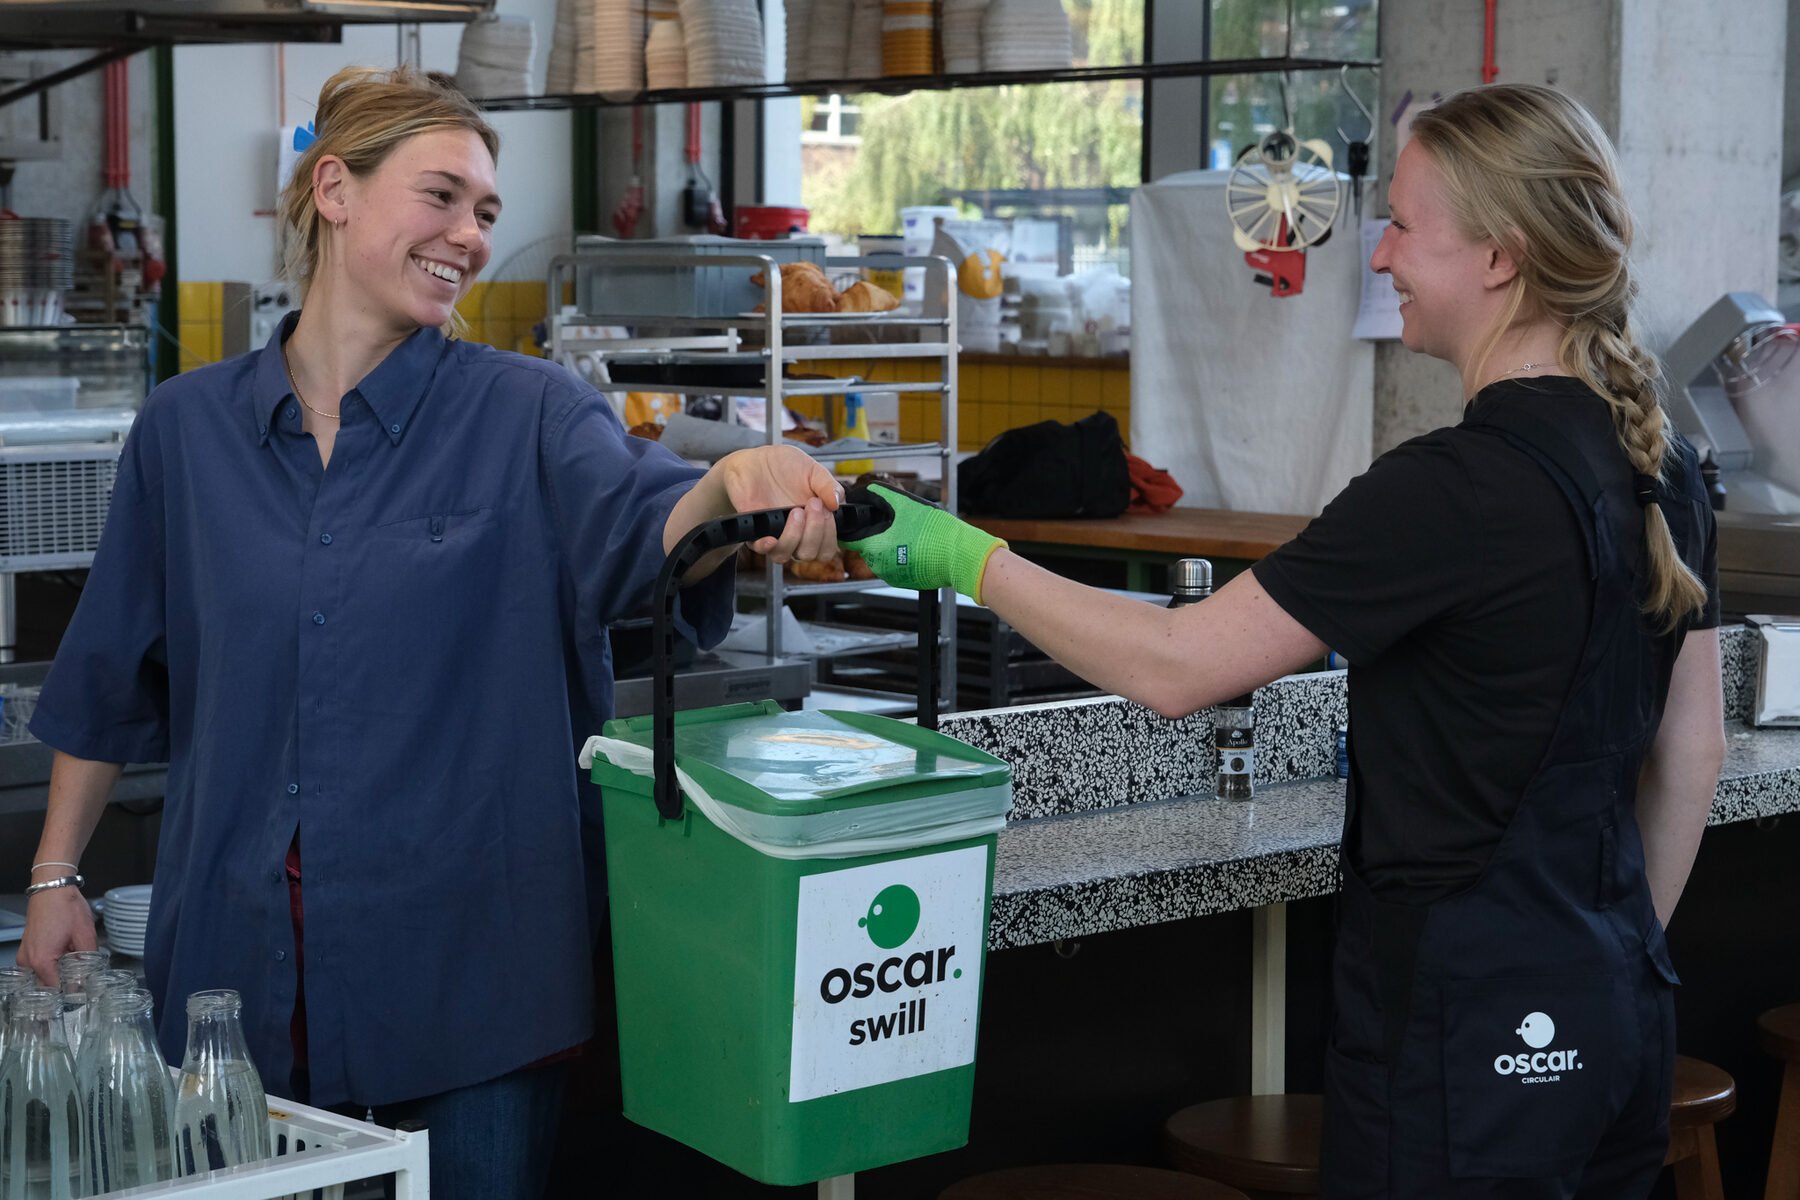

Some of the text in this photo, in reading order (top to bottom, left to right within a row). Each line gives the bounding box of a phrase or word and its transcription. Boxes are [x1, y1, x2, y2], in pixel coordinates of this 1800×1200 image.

[820, 945, 962, 1004] oscar.
[849, 998, 926, 1046] swill
[1494, 1049, 1583, 1075] oscar.
[1522, 1075, 1560, 1084] CIRCULAIR
